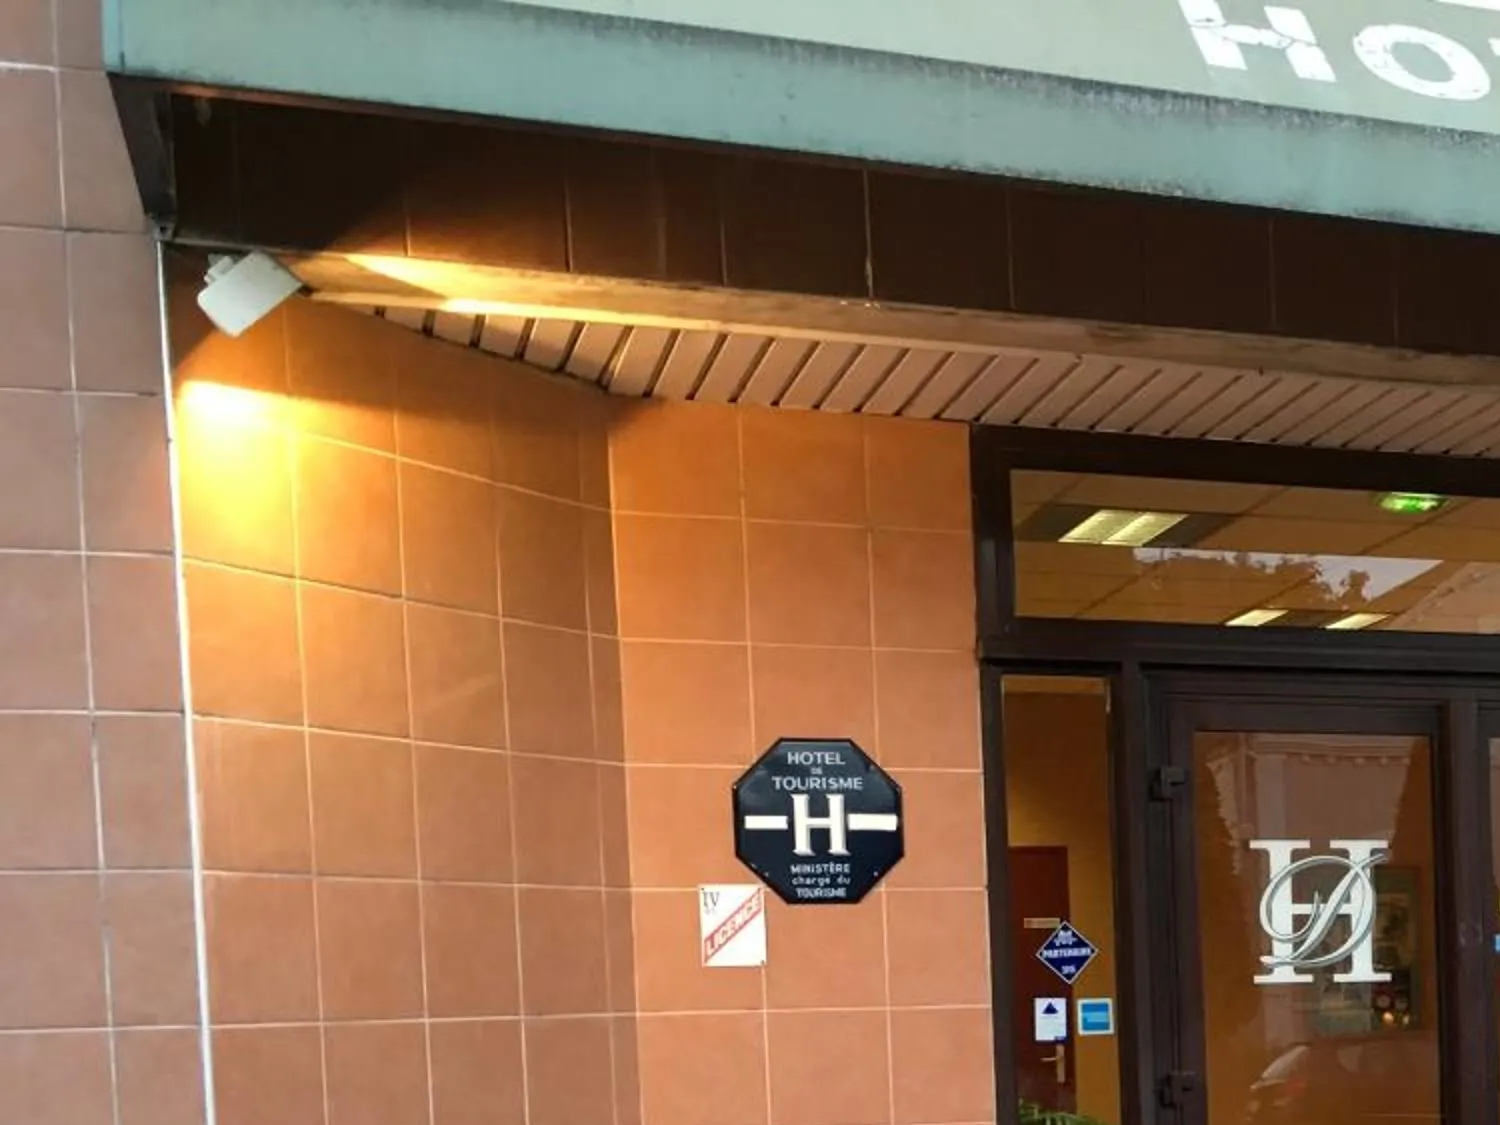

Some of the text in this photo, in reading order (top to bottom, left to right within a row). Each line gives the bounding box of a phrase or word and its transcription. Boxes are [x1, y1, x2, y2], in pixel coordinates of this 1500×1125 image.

[786, 750, 847, 766] HOTEL
[771, 775, 864, 791] TOURISME
[796, 887, 847, 899] TOURISME
